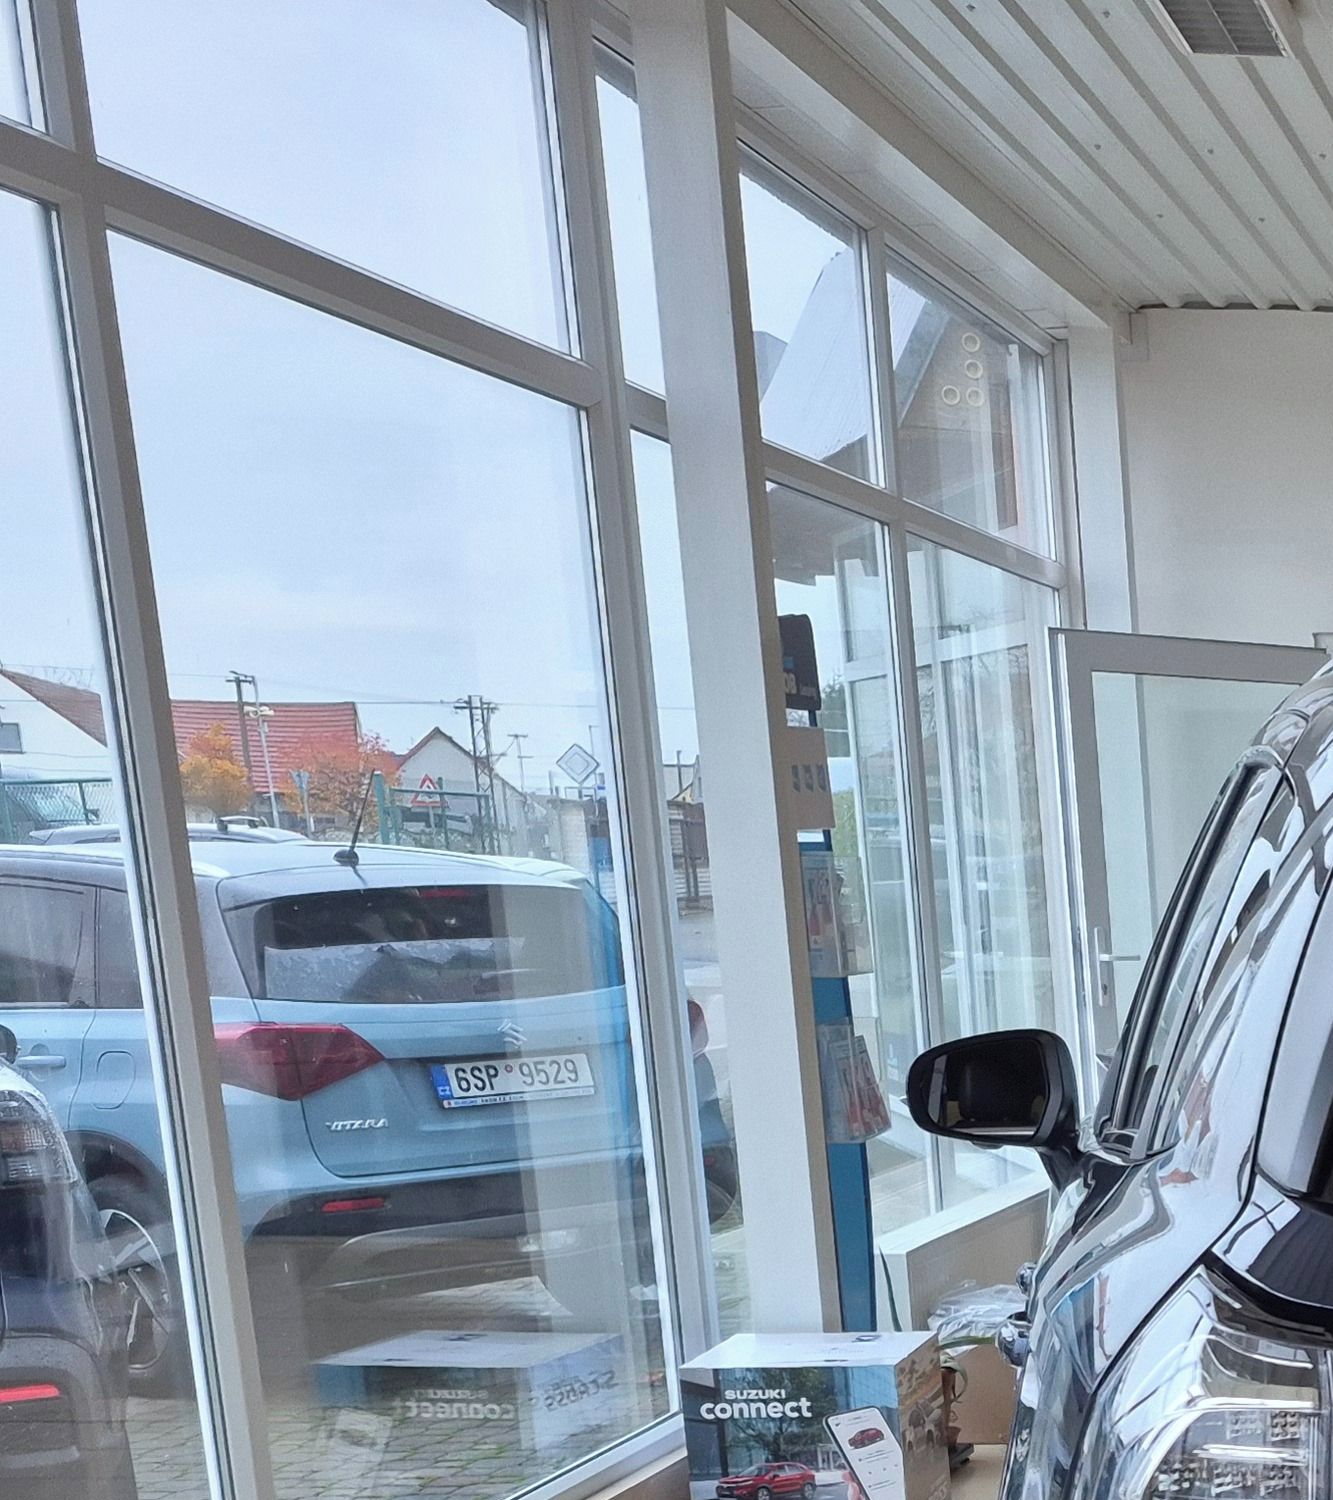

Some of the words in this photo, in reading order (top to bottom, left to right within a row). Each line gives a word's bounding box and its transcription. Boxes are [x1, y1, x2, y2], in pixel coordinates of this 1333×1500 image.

[455, 1063, 498, 1093] 6SP
[518, 1058, 579, 1087] 9529
[724, 1388, 786, 1400] SUZUKI
[699, 1397, 813, 1420] connect
